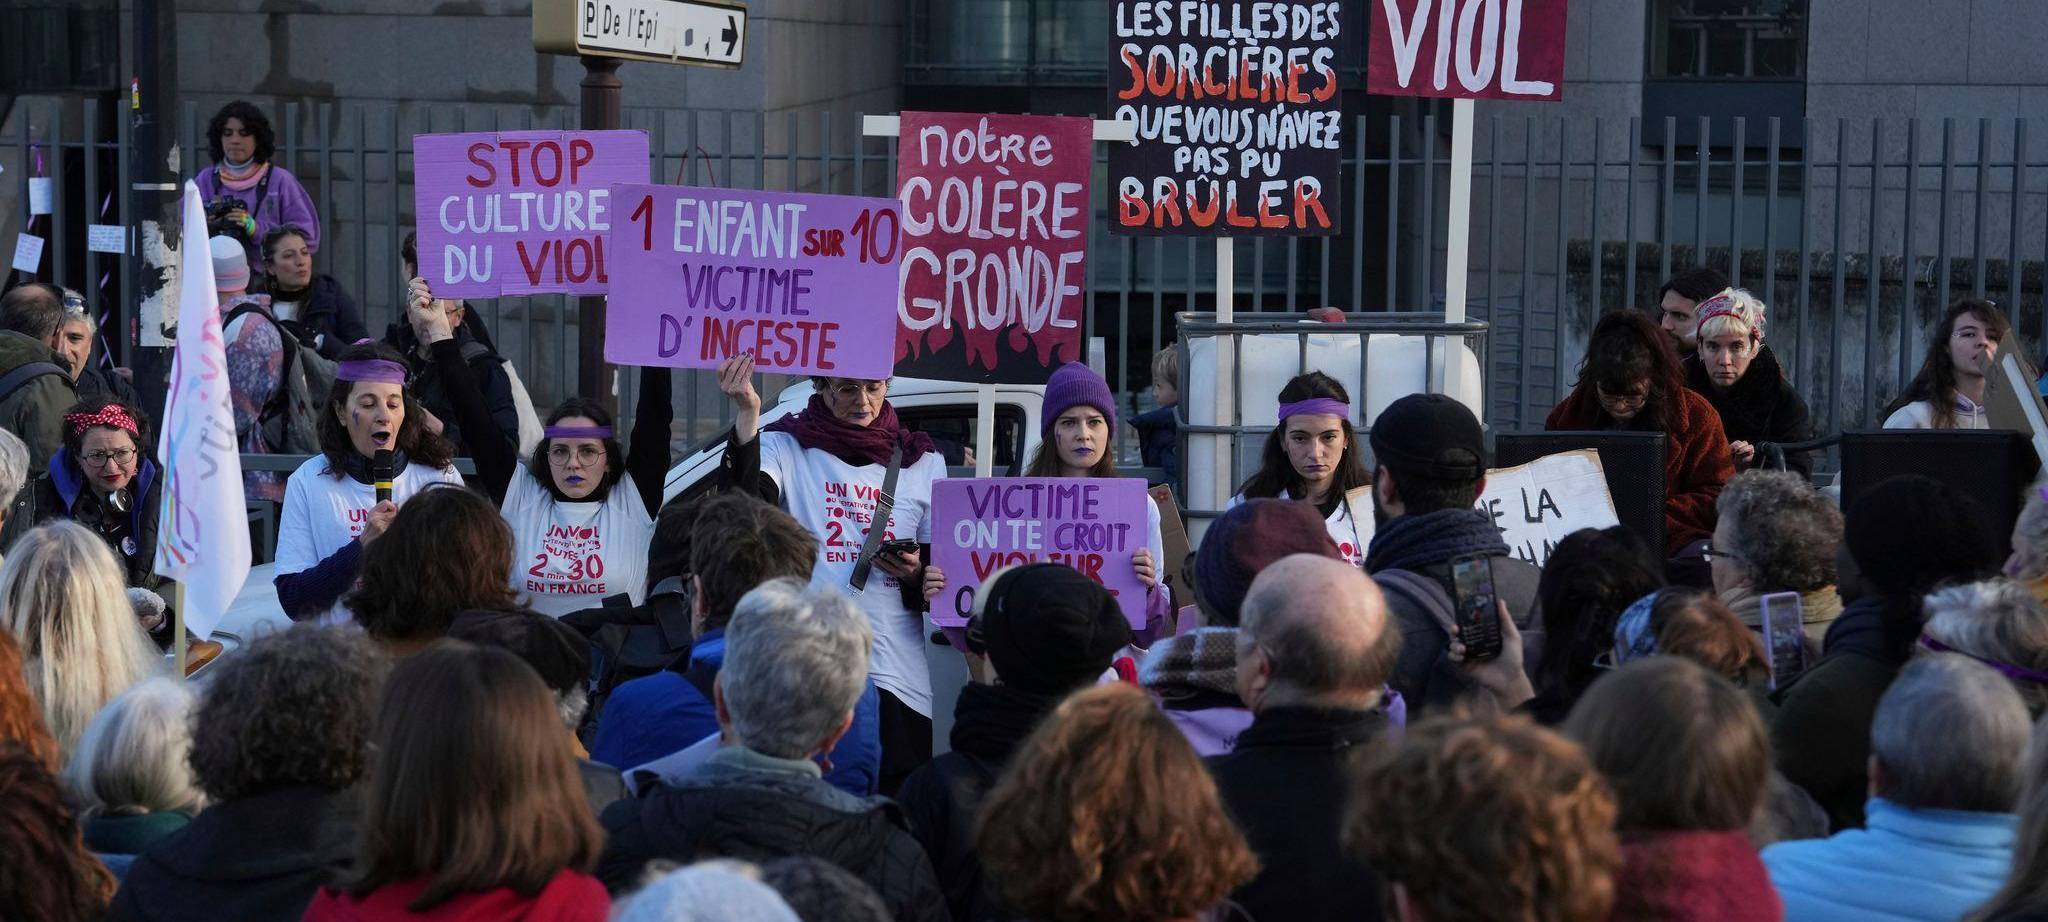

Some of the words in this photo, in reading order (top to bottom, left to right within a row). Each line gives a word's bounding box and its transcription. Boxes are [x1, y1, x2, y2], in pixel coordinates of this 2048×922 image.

[603, 5, 620, 36] De
[627, 7, 659, 48] l'Epi
[1116, 1, 1173, 37] LES
[1180, 1, 1288, 39] FILLES
[1291, 1, 1340, 41] DES
[1383, 0, 1555, 96] VIOL
[1118, 38, 1338, 103] SORCIÈRES
[1185, 106, 1255, 149] VOUS
[466, 138, 594, 187] STOP
[1174, 146, 1229, 175] PAS
[1240, 148, 1281, 178] PU
[439, 188, 610, 234] CULTURE
[899, 165, 1083, 240] COLÈRE
[1119, 174, 1331, 228] BRÛLER
[630, 194, 653, 251] 1
[673, 197, 807, 259] ENFANT
[802, 228, 845, 257] SUR
[850, 208, 899, 265] 10
[443, 244, 493, 284] DU
[515, 234, 608, 286] VIOL
[682, 263, 813, 316] VICTIME
[897, 246, 1084, 333] GRONDE
[700, 316, 840, 370] INCESTE
[825, 481, 848, 498] UN
[966, 484, 1100, 520] VICTIME
[1520, 487, 1562, 523] LA
[825, 521, 844, 547] 2
[954, 519, 998, 549] ON
[1006, 519, 1042, 550] TE
[1054, 523, 1131, 552] CROIT
[528, 554, 549, 577] 2
[567, 553, 604, 581] 30
[826, 552, 847, 562] EN
[526, 580, 545, 593] EN
[549, 583, 606, 594] FRANCE
